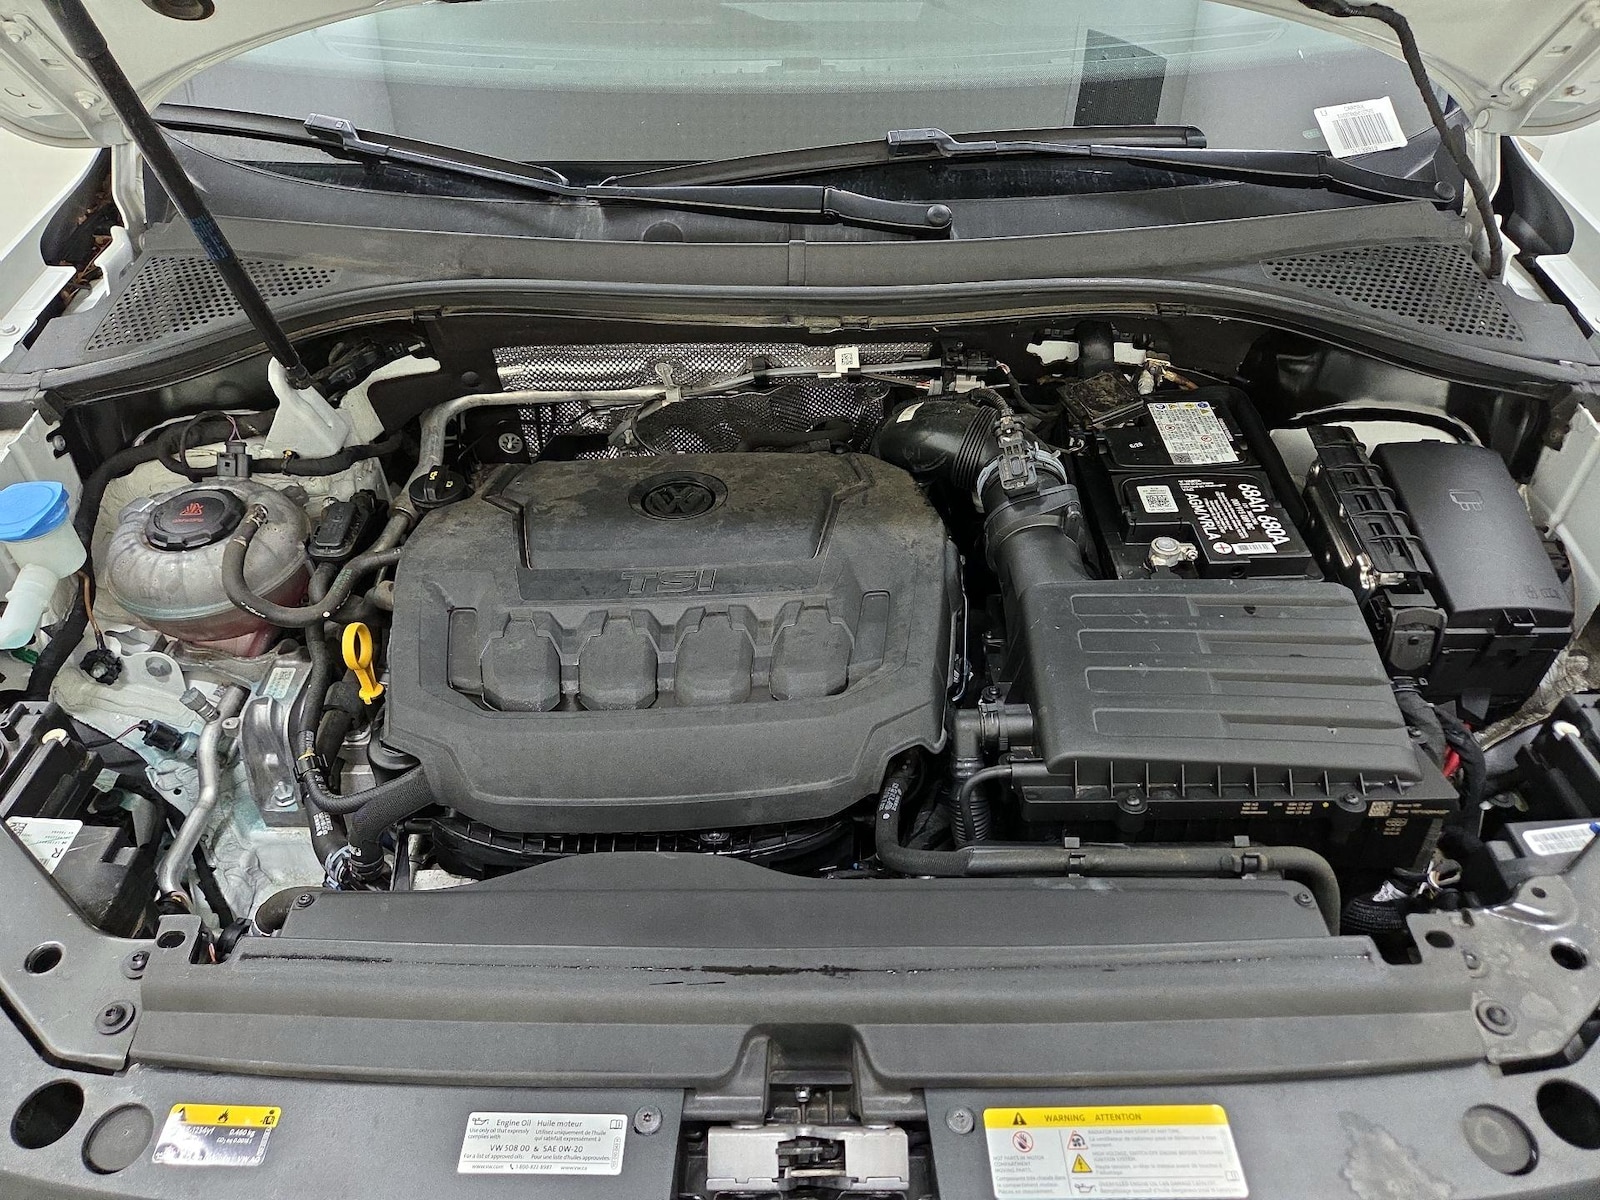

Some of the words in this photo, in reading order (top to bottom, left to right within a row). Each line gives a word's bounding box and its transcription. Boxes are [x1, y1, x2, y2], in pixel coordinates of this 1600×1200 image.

[1237, 483, 1270, 513] 68Ah
[1257, 515, 1291, 546] 680A
[621, 568, 717, 595] TSI
[51, 847, 64, 859] R
[1043, 1114, 1086, 1122] WARNING
[1095, 1112, 1142, 1121] ATTENTION
[496, 1119, 520, 1128] Engine
[521, 1119, 532, 1127] Oil
[537, 1119, 556, 1127] Huile
[556, 1120, 583, 1128] moteur
[504, 1144, 519, 1152] 508
[519, 1144, 531, 1152] 00
[543, 1145, 557, 1153] SAE
[558, 1145, 584, 1153] 0W-20
